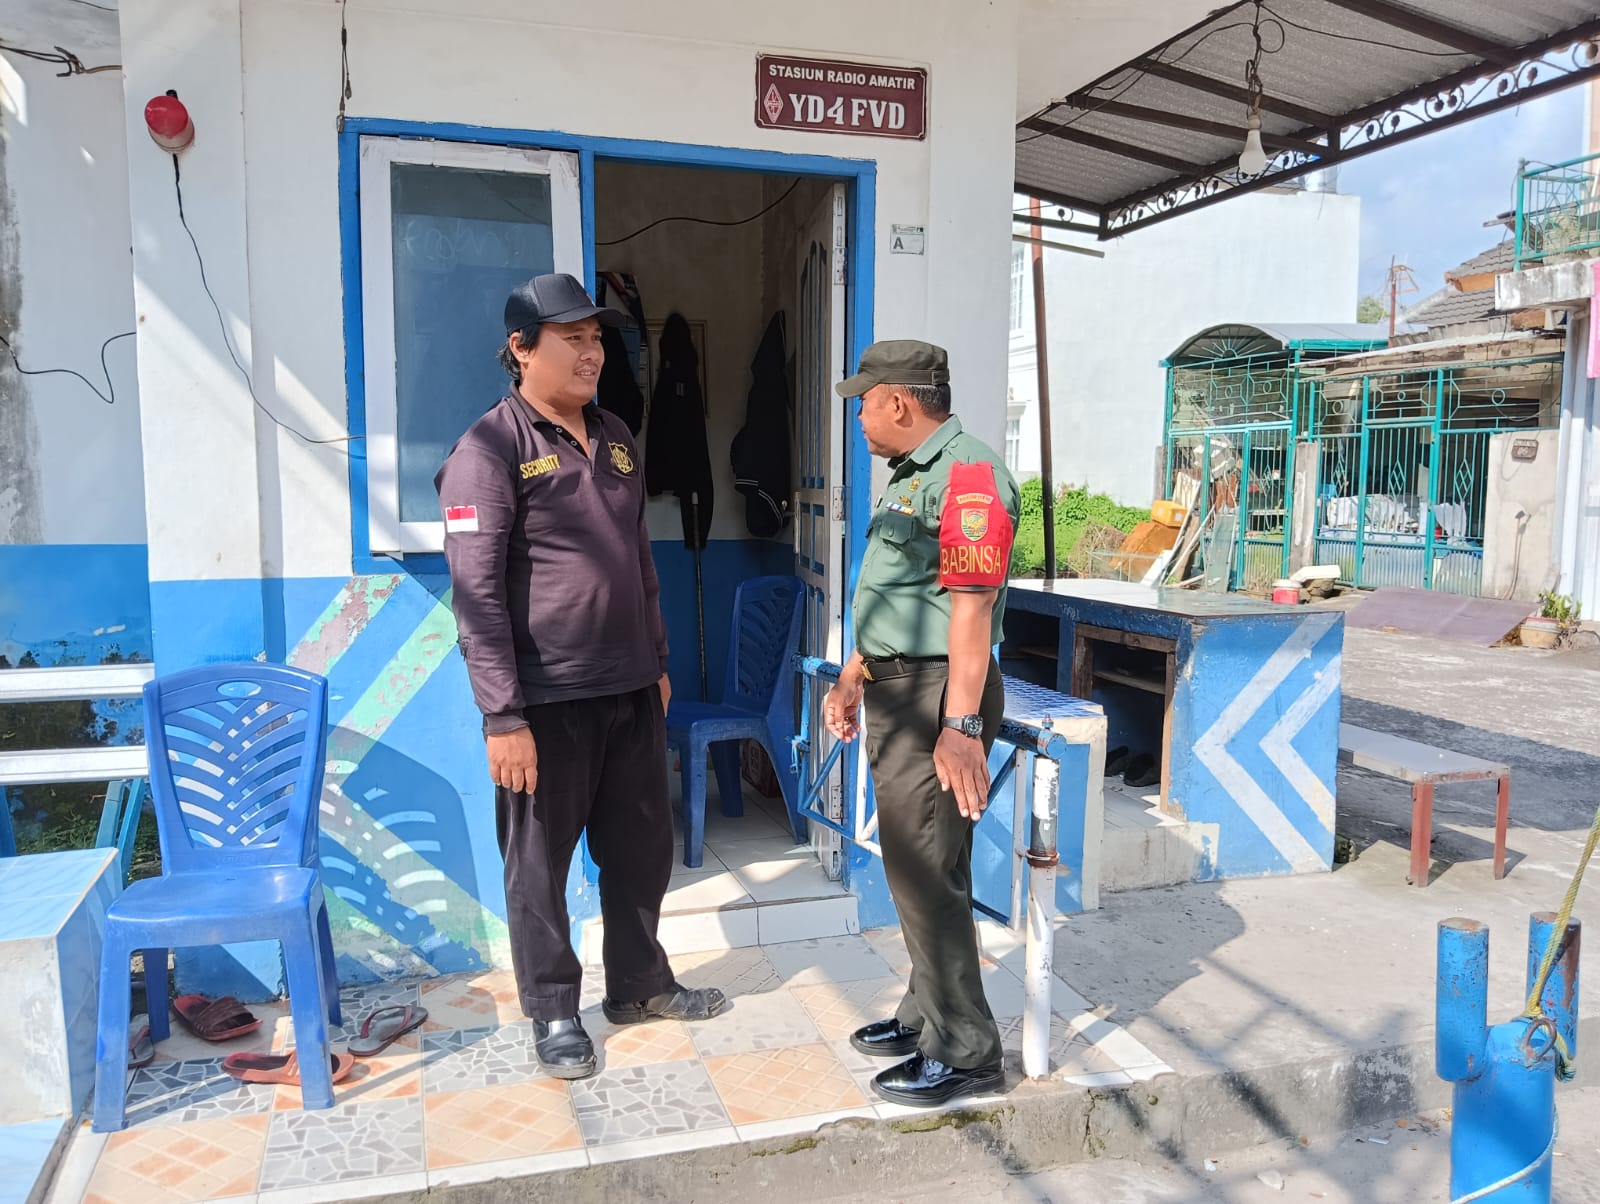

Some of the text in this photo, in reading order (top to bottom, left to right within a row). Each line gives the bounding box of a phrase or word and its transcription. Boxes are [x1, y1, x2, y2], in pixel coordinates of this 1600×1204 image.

[769, 64, 916, 90] STASIUN RADIO AMATIR
[893, 236, 904, 250] A
[519, 453, 561, 480] SECURITY
[941, 544, 1002, 576] BABINSA
